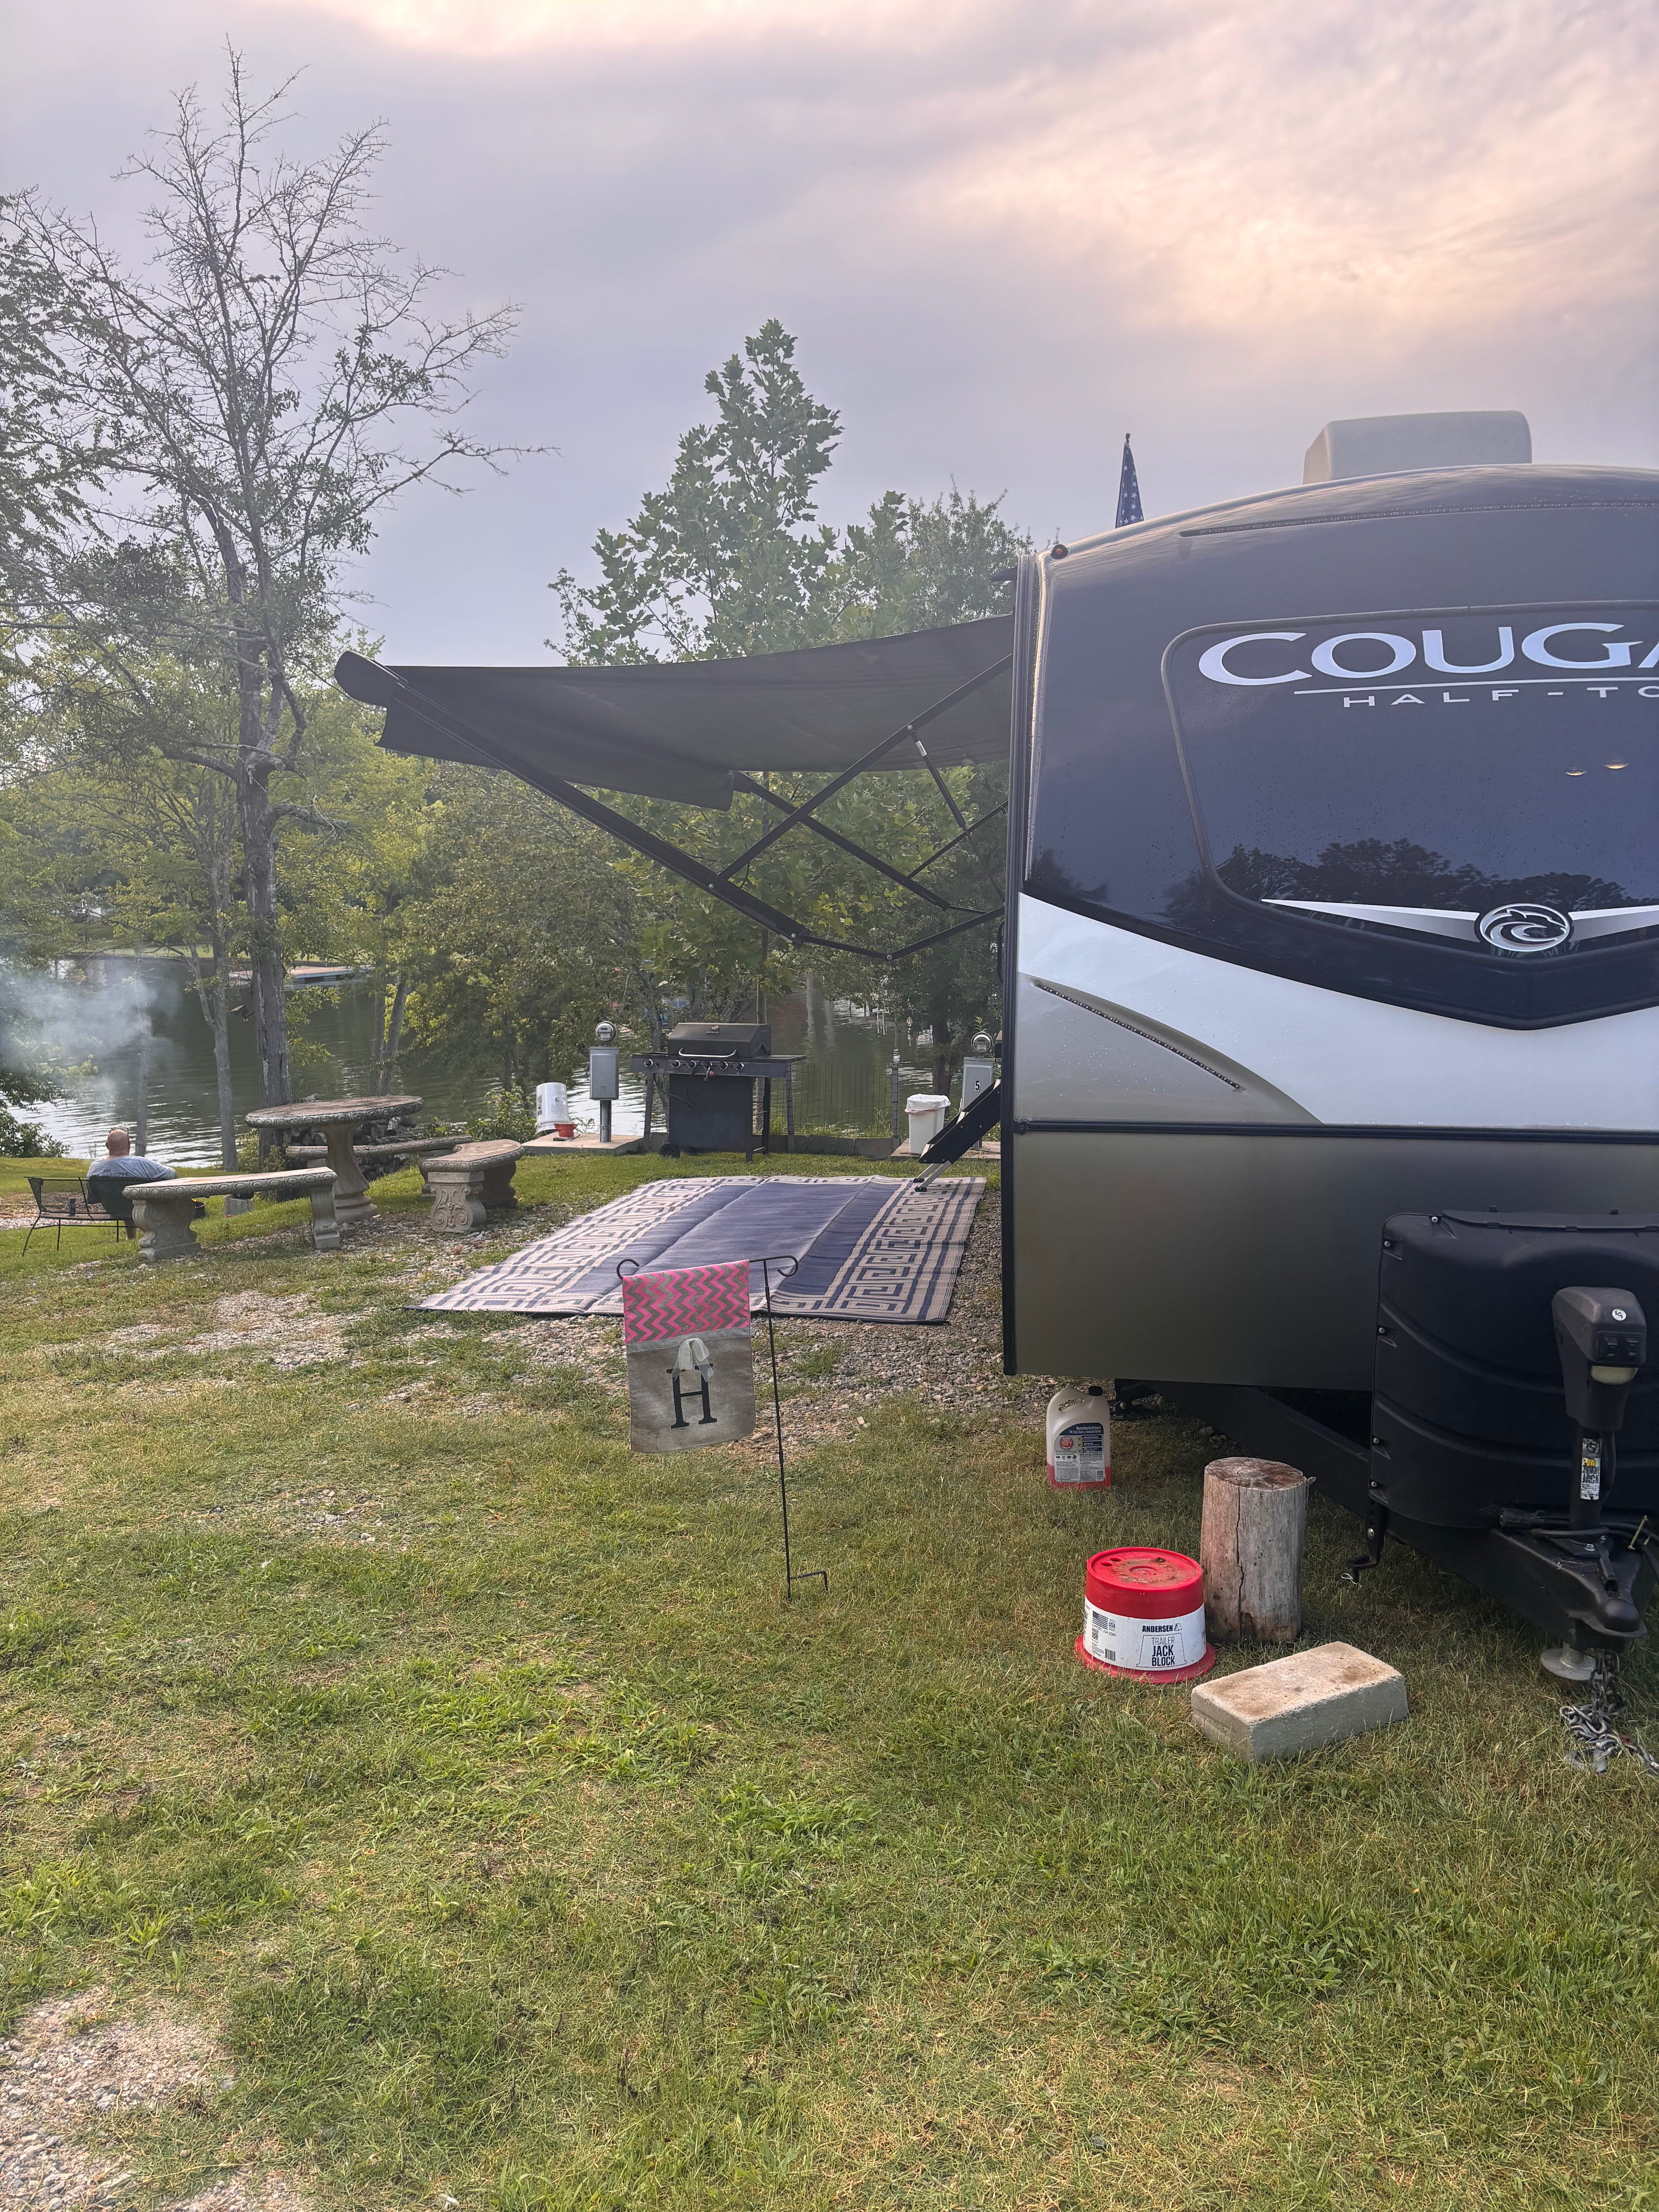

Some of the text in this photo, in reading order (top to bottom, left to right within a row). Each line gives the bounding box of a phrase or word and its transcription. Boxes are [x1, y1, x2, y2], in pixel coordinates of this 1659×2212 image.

[975, 1080, 980, 1090] 5
[666, 1363, 717, 1429] H
[1151, 1636, 1175, 1646] TRAILER
[1152, 1644, 1174, 1657] JACK
[1152, 1656, 1175, 1666] BLOCK
